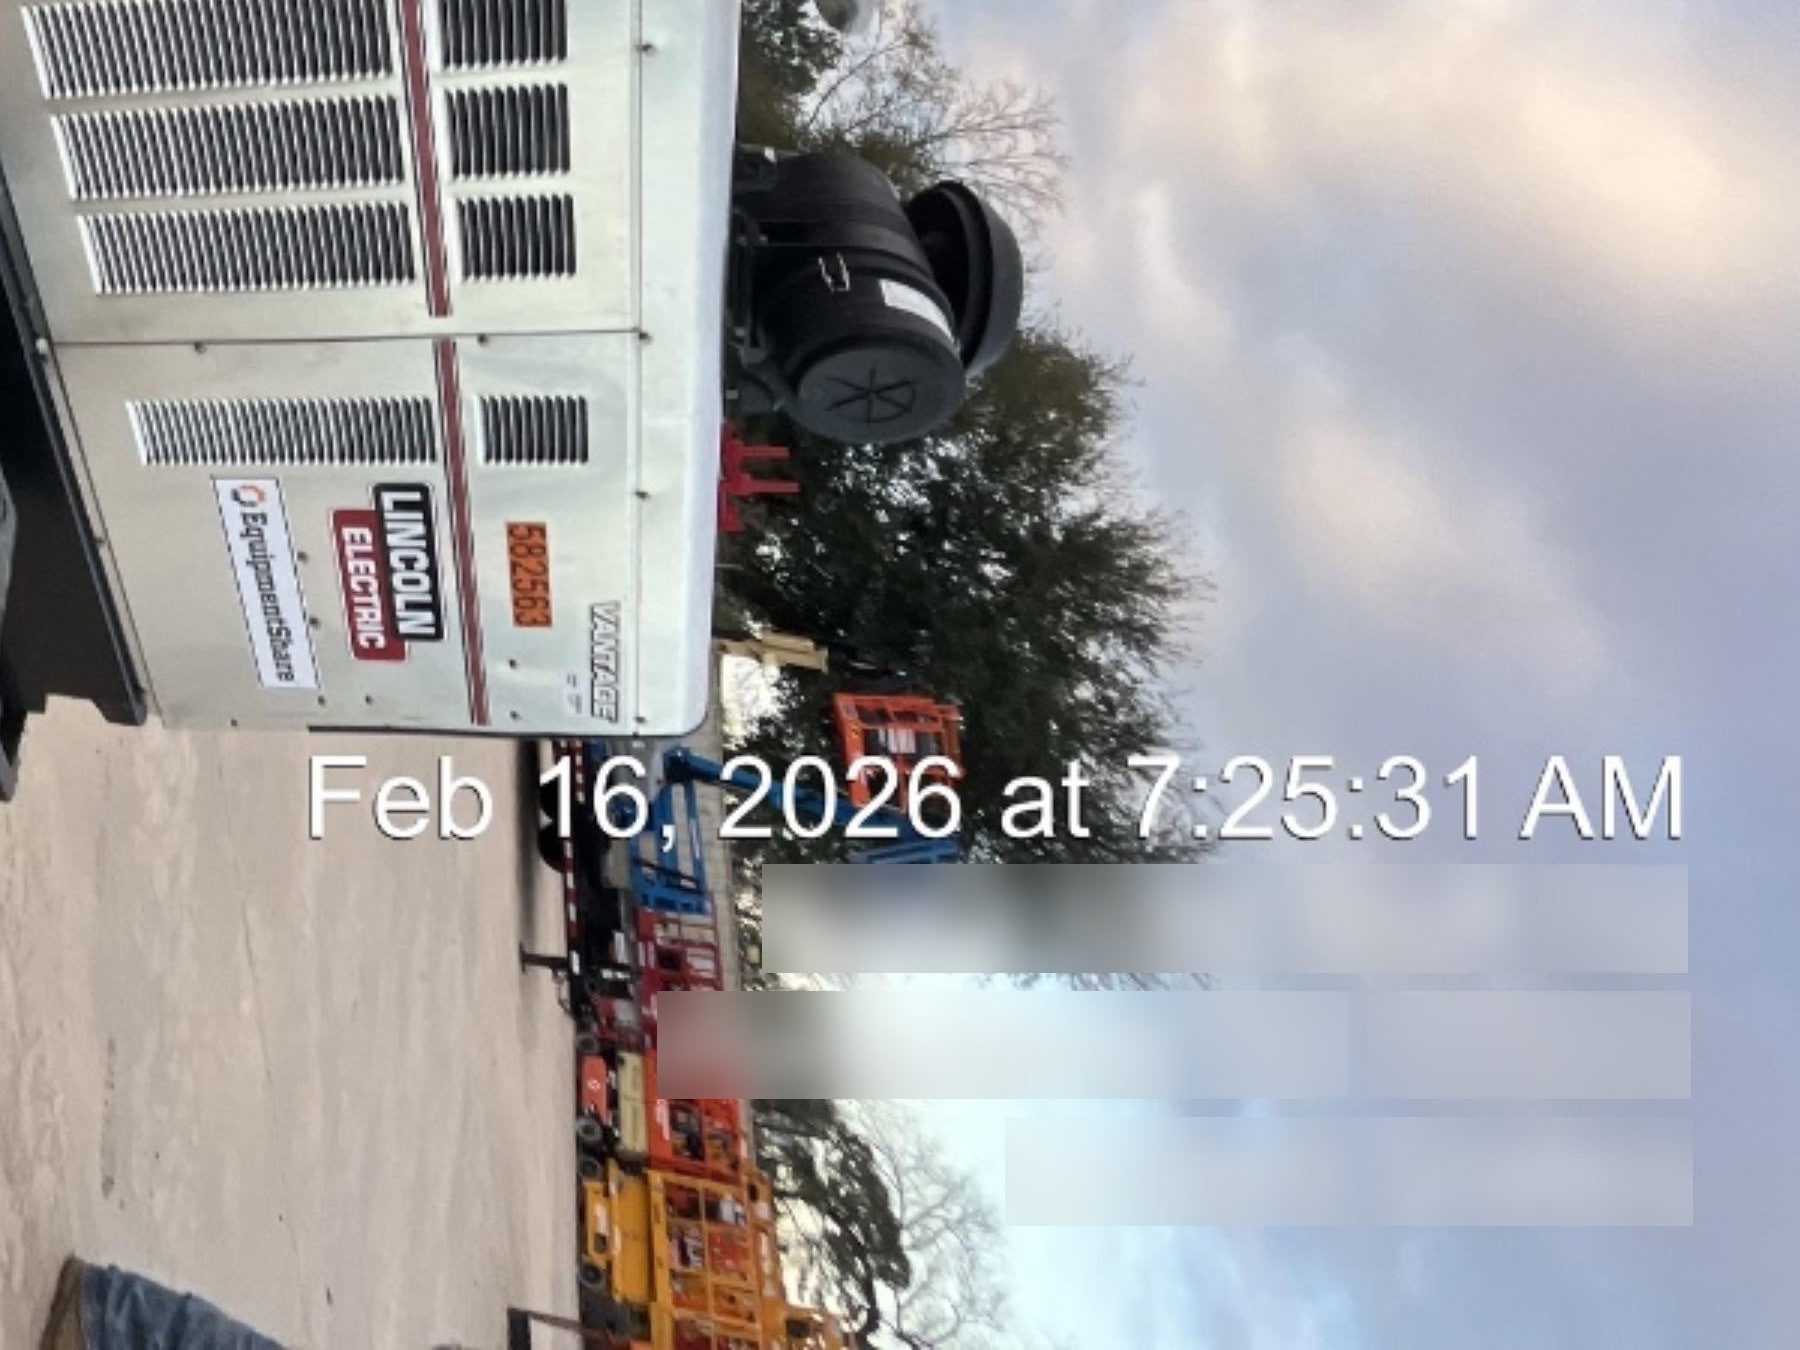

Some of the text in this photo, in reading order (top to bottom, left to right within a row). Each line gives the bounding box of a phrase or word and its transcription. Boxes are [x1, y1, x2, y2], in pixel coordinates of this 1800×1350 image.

[238, 512, 295, 682] EquipmentShare
[342, 527, 386, 649] ELECTRIC
[381, 490, 436, 635] LINCOLN
[507, 523, 552, 627] 582563
[590, 601, 620, 723] VANTAGE
